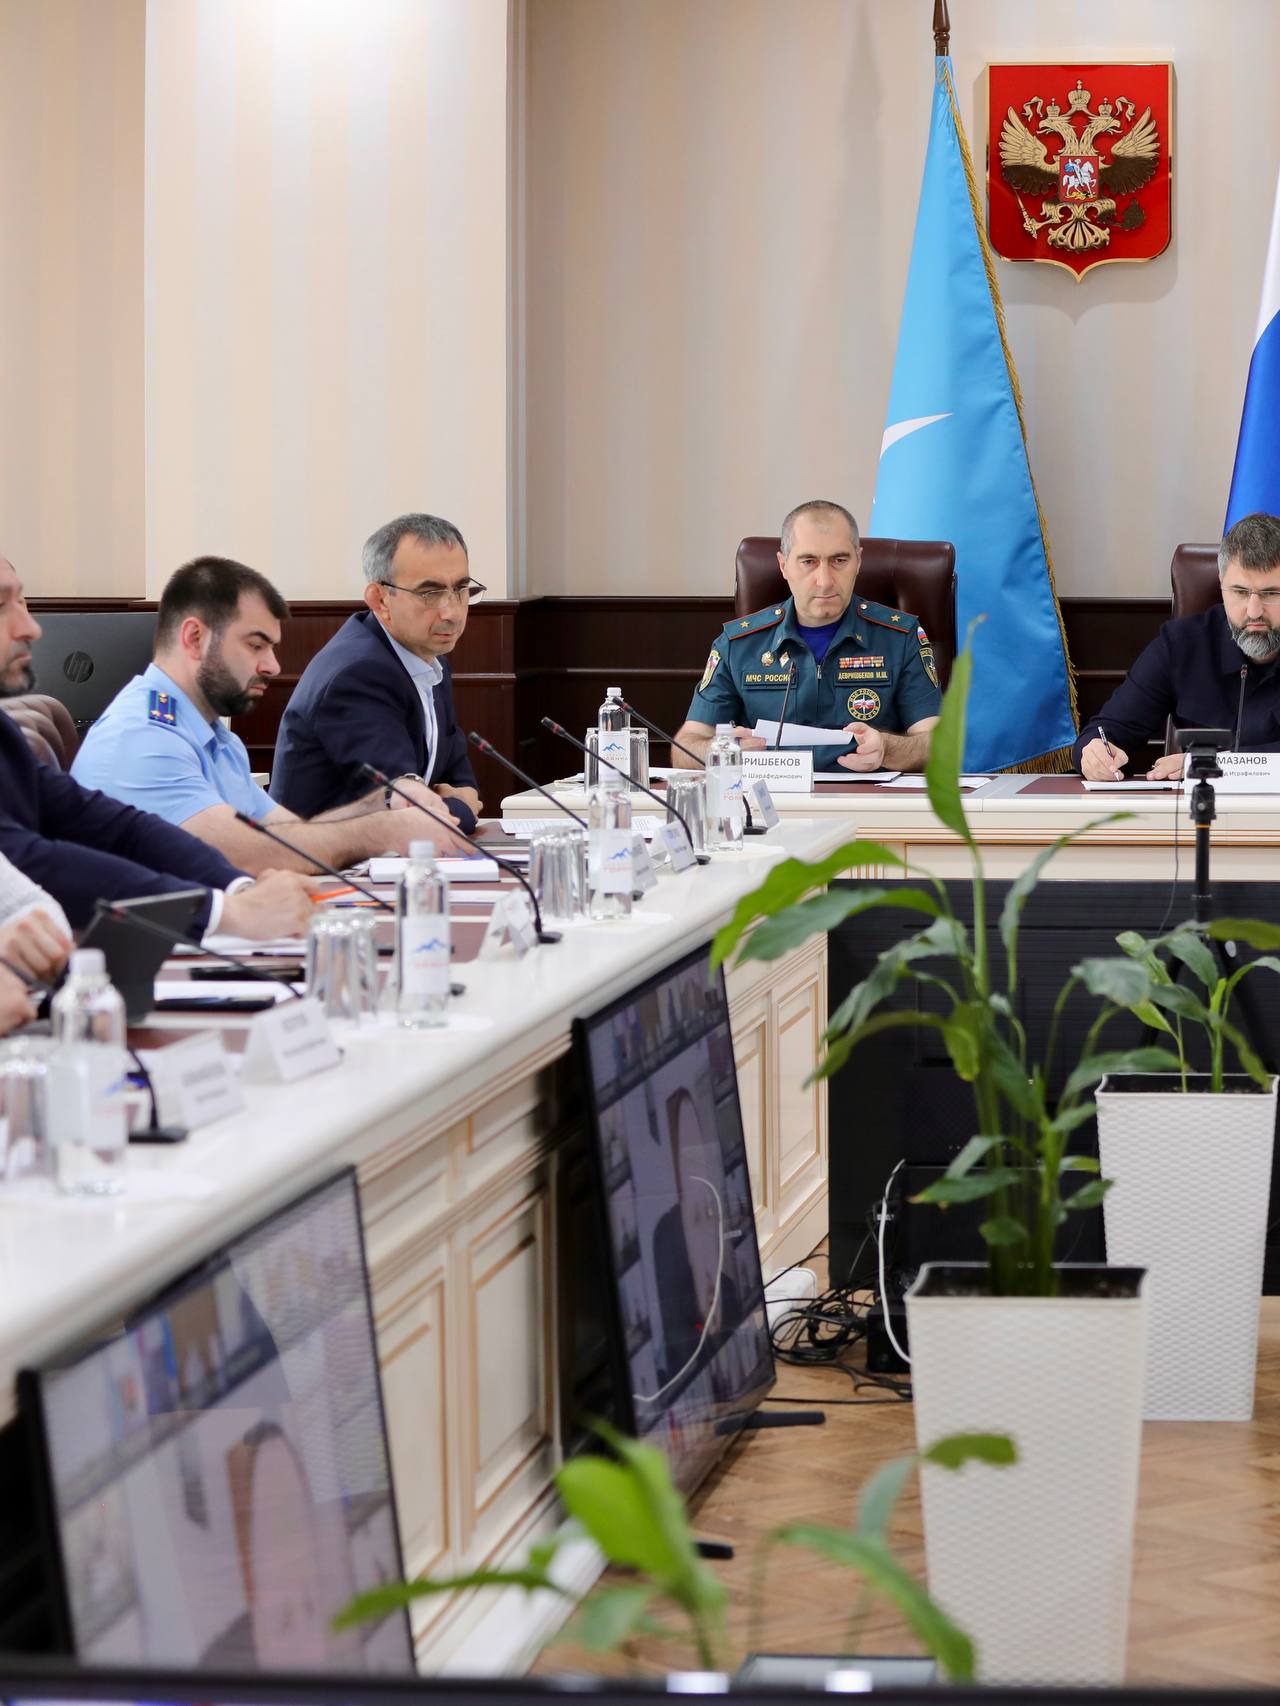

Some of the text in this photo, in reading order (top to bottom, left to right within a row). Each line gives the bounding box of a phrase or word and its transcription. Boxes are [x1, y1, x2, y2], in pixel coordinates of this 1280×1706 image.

[66, 651, 92, 684] hp
[745, 674, 762, 683] МЧС
[740, 757, 801, 767] РИШБЕКОВ
[1216, 756, 1268, 765] МАЗАНОВ
